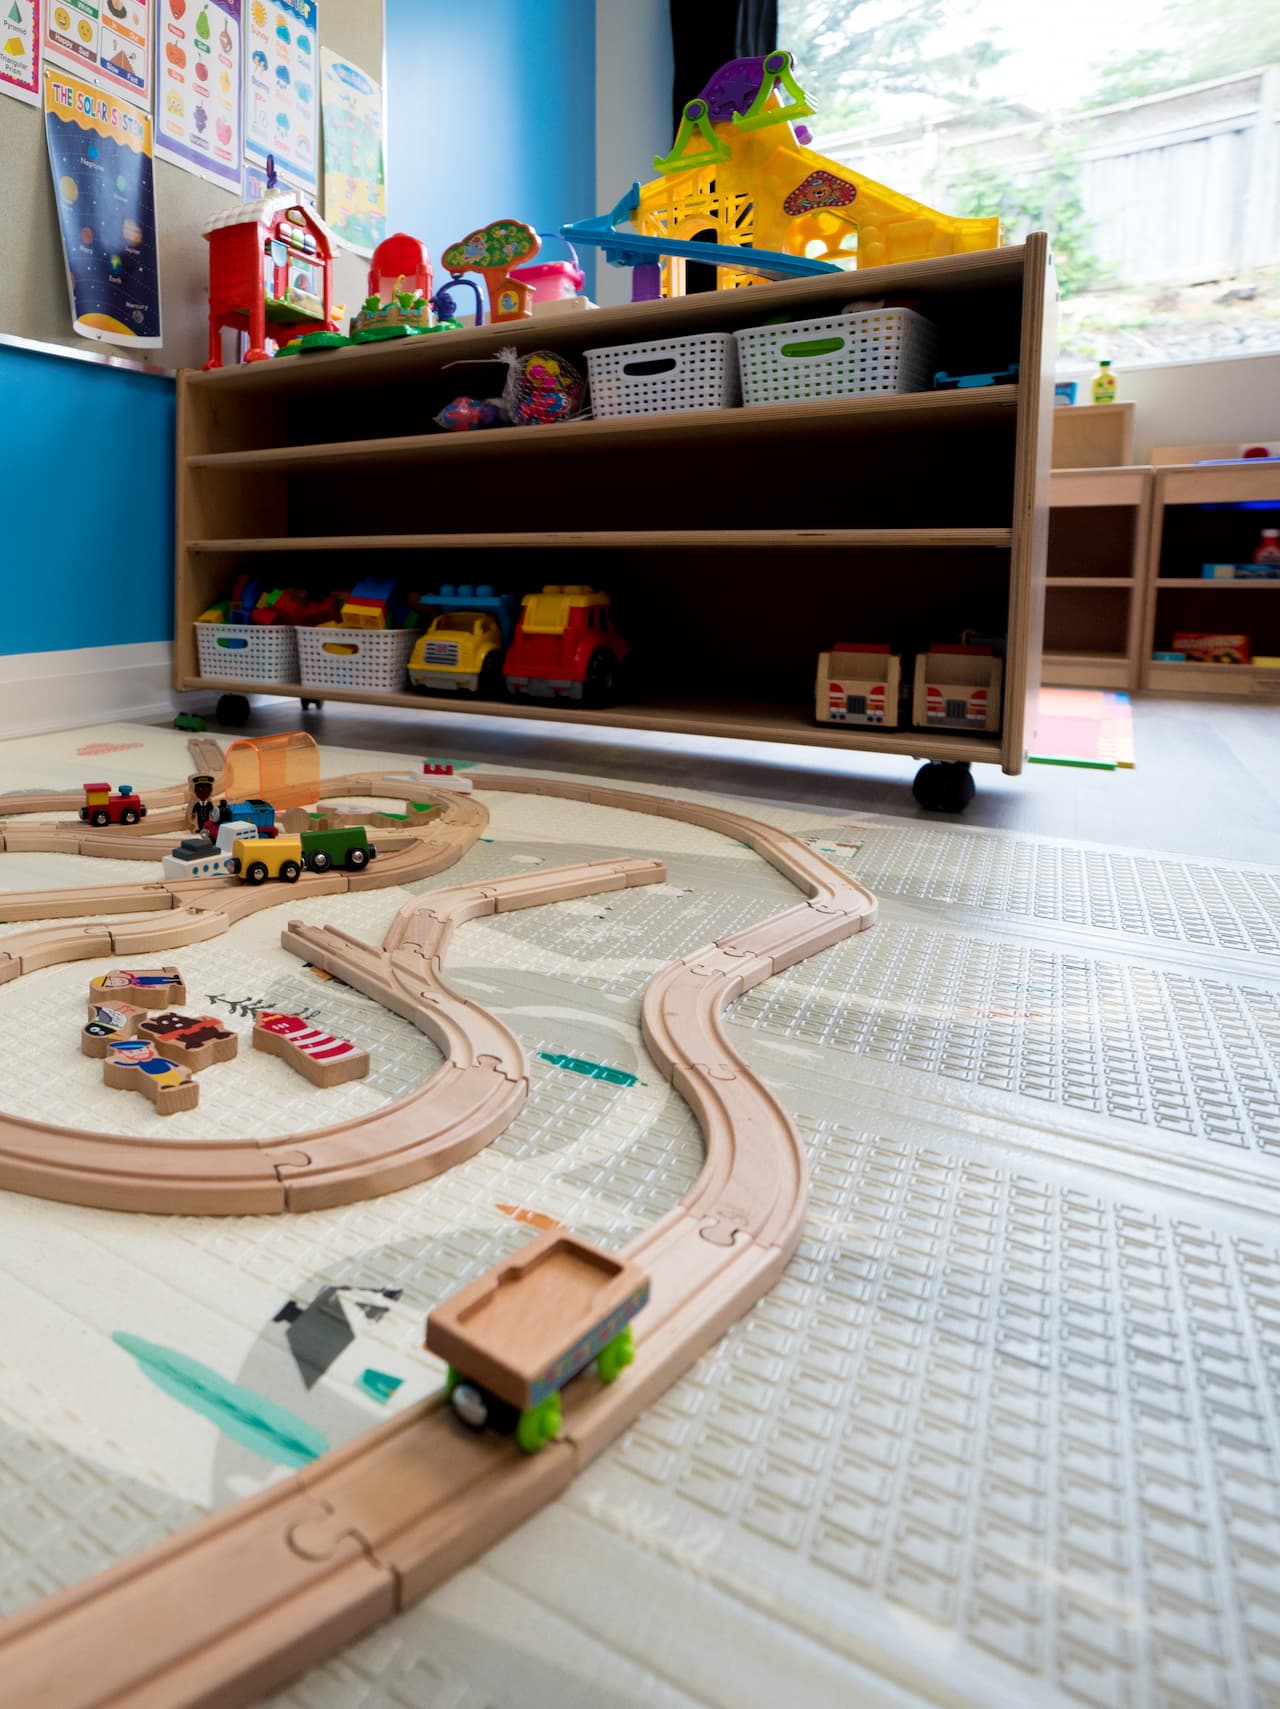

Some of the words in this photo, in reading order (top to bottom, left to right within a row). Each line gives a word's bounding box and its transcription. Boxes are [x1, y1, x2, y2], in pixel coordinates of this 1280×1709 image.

[3, 19, 27, 36] Pyramid
[54, 33, 73, 49] Happy
[0, 53, 28, 70] Triangular
[5, 63, 22, 76] Prism
[52, 82, 73, 107] THE
[76, 90, 109, 123] SOLAR
[80, 157, 105, 173] Neptune
[125, 301, 149, 312] Mercury
